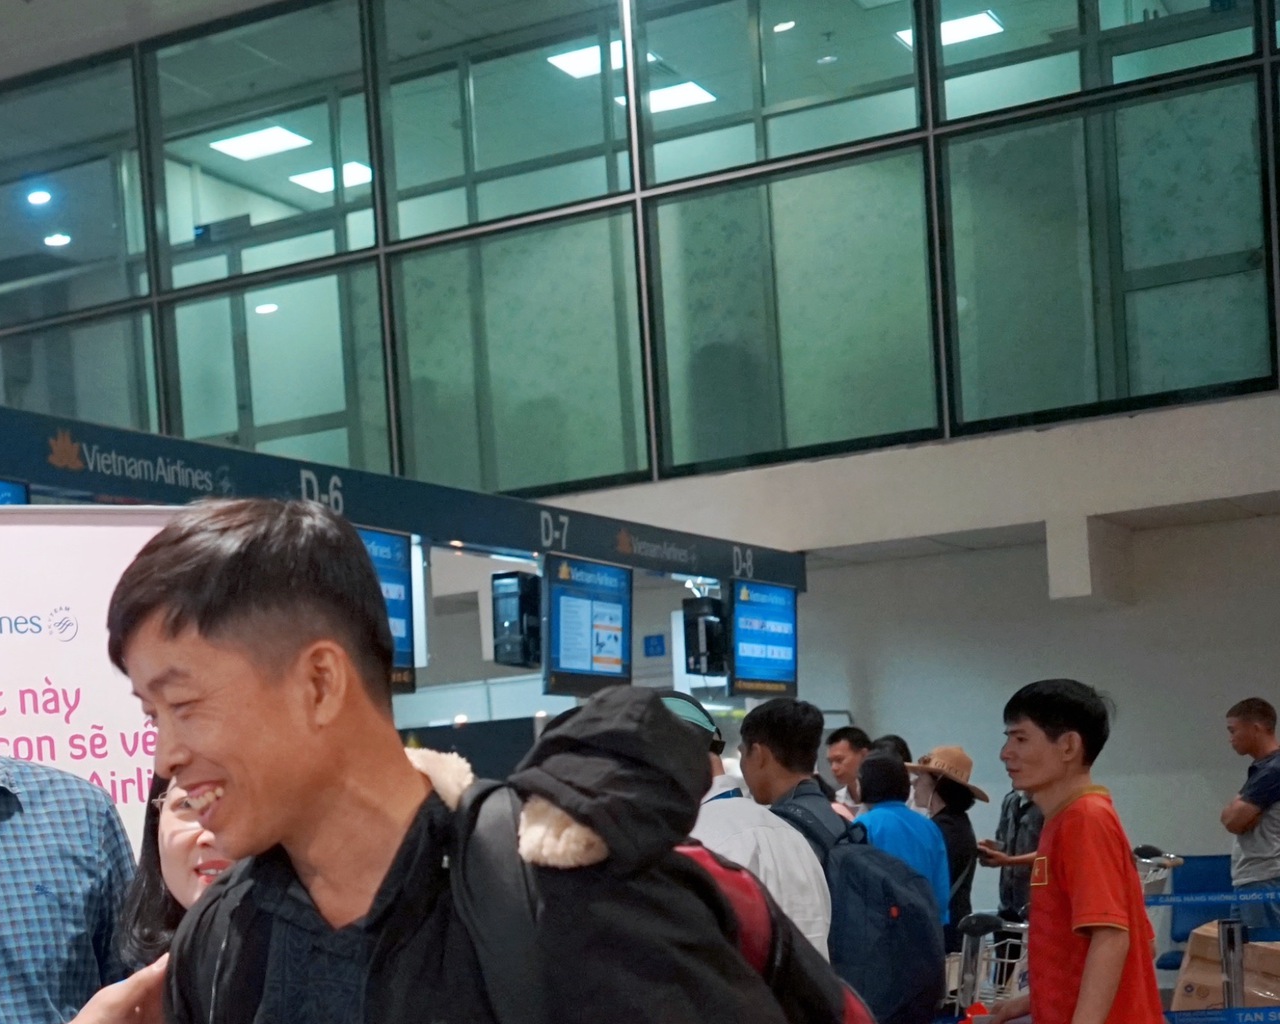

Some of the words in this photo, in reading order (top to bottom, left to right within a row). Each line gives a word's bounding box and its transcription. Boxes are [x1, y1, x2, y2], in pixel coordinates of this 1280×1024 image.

[82, 443, 155, 482] Vietnam
[155, 456, 214, 492] Airlines
[300, 470, 344, 514] D-6
[540, 511, 570, 549] D-7
[733, 547, 754, 578] D-8
[19, 677, 81, 724] này
[69, 725, 108, 760] sẽ
